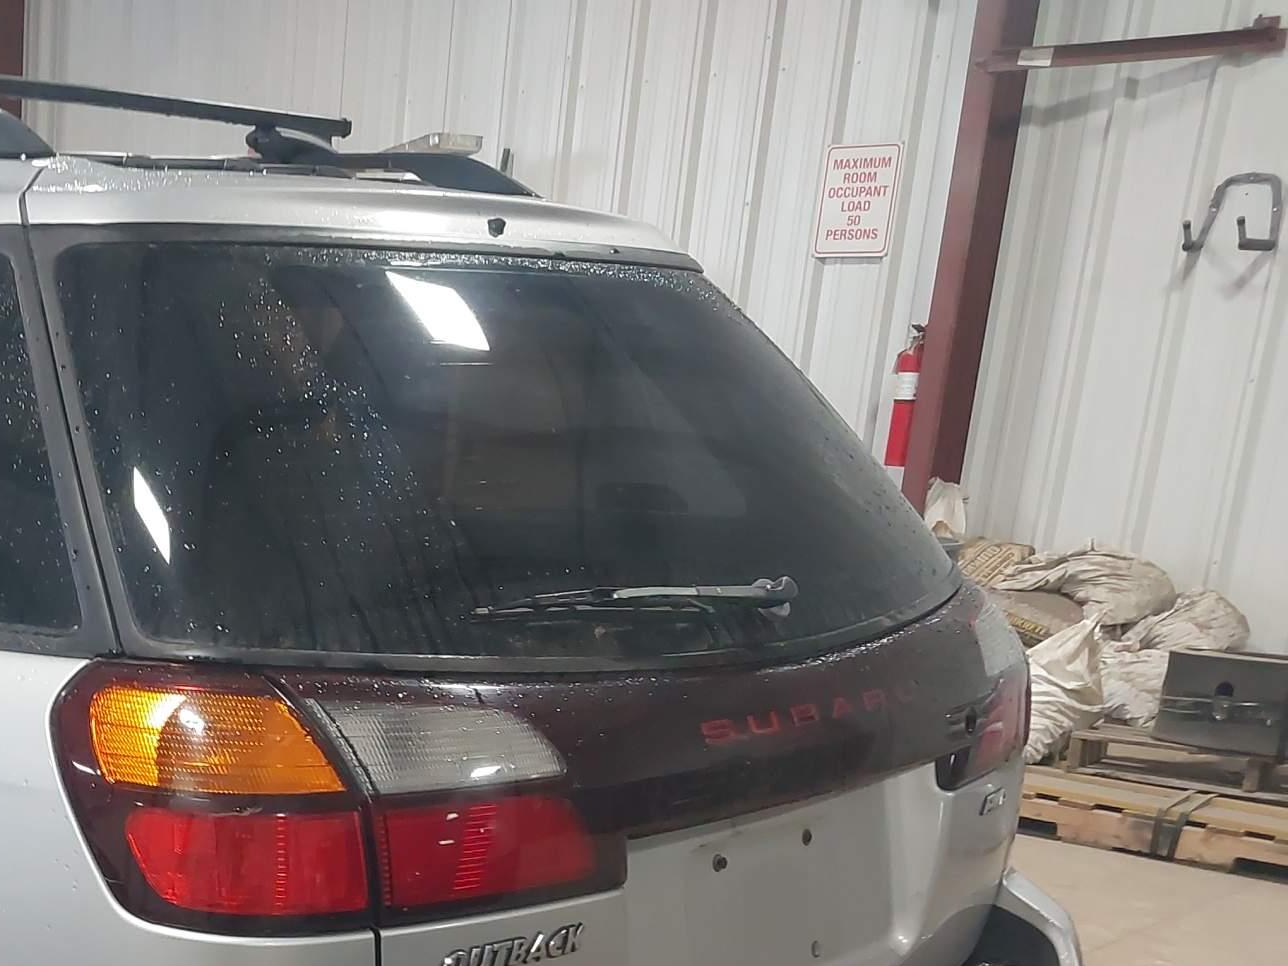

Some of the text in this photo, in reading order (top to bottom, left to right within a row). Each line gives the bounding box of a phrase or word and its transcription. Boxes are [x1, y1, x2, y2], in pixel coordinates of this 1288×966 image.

[833, 156, 892, 170] MAXIMUM
[843, 172, 878, 184] ROOM
[828, 185, 889, 198] OCCUPANT
[841, 200, 871, 212] LOAD
[847, 215, 861, 226] 50
[825, 228, 879, 241] PERSONS
